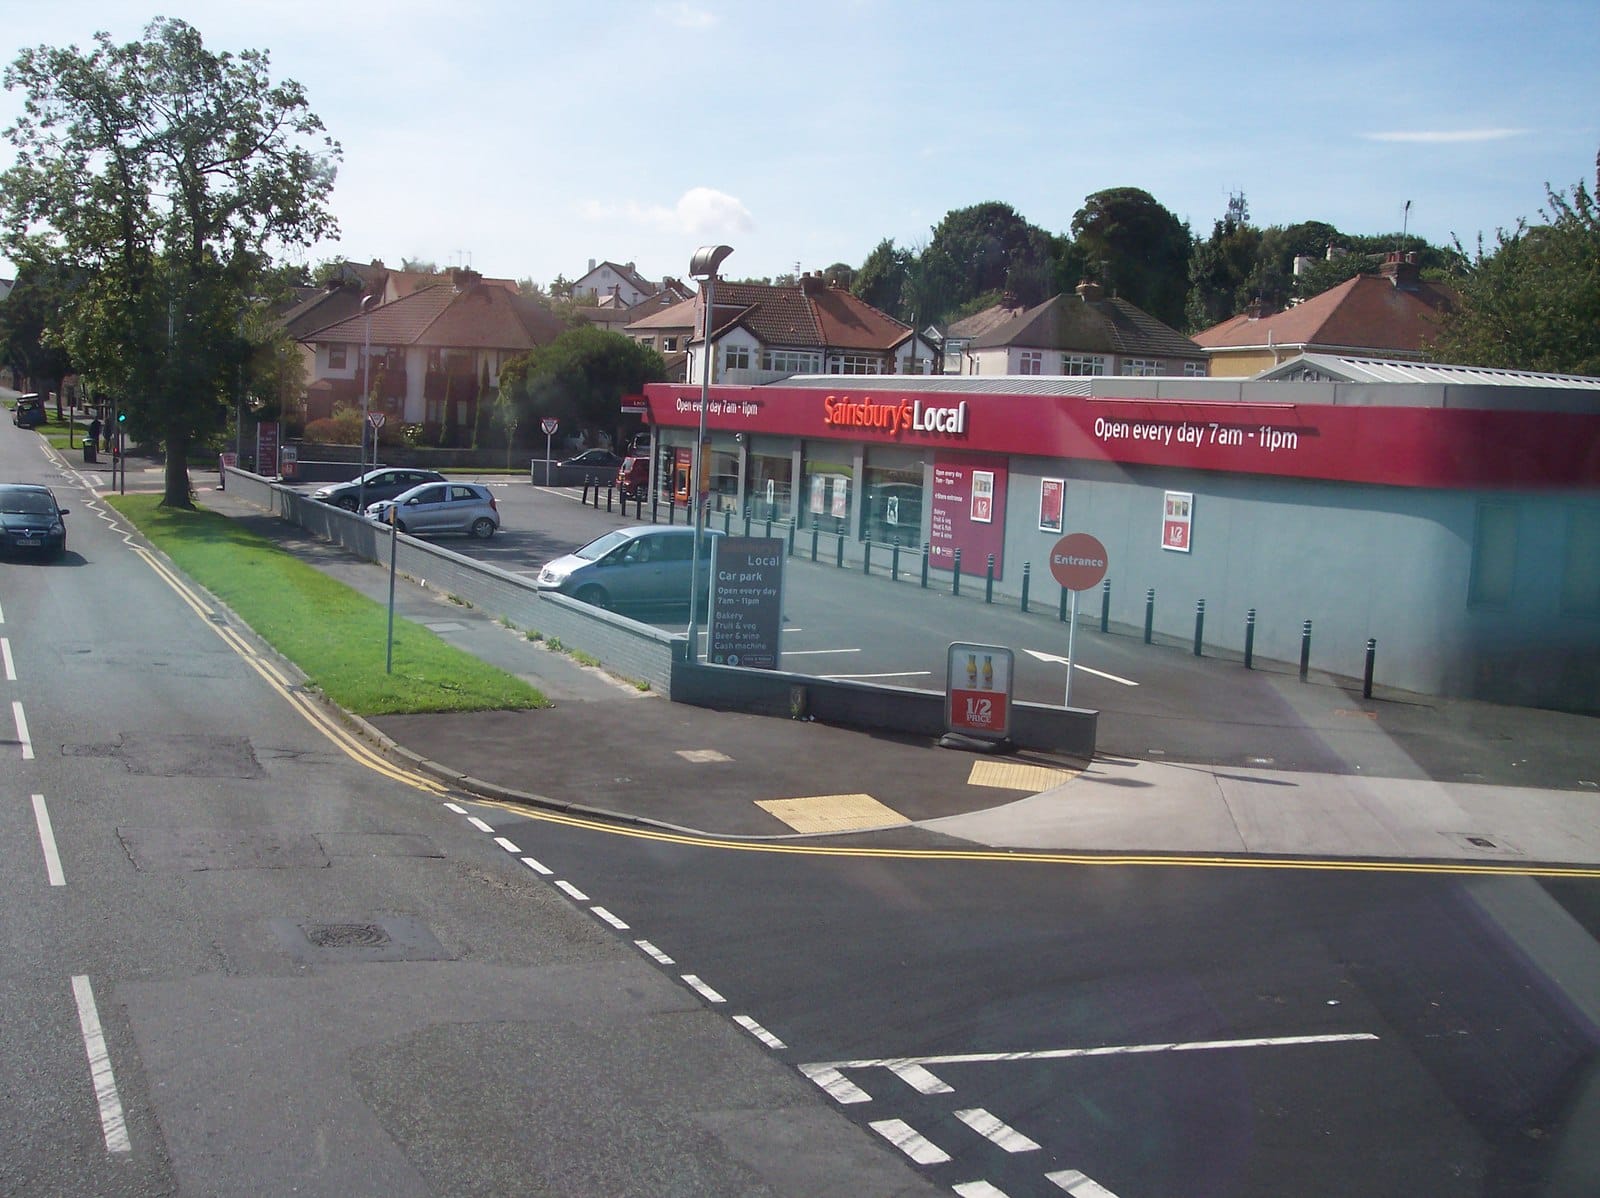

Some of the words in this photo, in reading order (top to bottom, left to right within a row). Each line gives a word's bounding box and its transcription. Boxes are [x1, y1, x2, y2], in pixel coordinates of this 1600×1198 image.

[676, 398, 691, 413] Open
[692, 401, 710, 413] eve
[710, 400, 721, 416] day
[722, 400, 737, 414] 7am
[824, 395, 912, 435] Sainsbury's
[913, 400, 967, 433] Local
[1094, 417, 1129, 441] Open
[1133, 424, 1173, 446] every
[1177, 421, 1204, 447] day
[1208, 423, 1243, 445] 7am
[1259, 426, 1298, 452] 11pm
[748, 555, 779, 567] Local
[1054, 554, 1104, 568] Entrance
[719, 571, 737, 581] Car
[739, 571, 762, 583] park
[718, 587, 738, 596] Open
[739, 587, 761, 596] every
[763, 587, 777, 596] day
[718, 597, 734, 605] 7am
[714, 642, 734, 650] Cash
